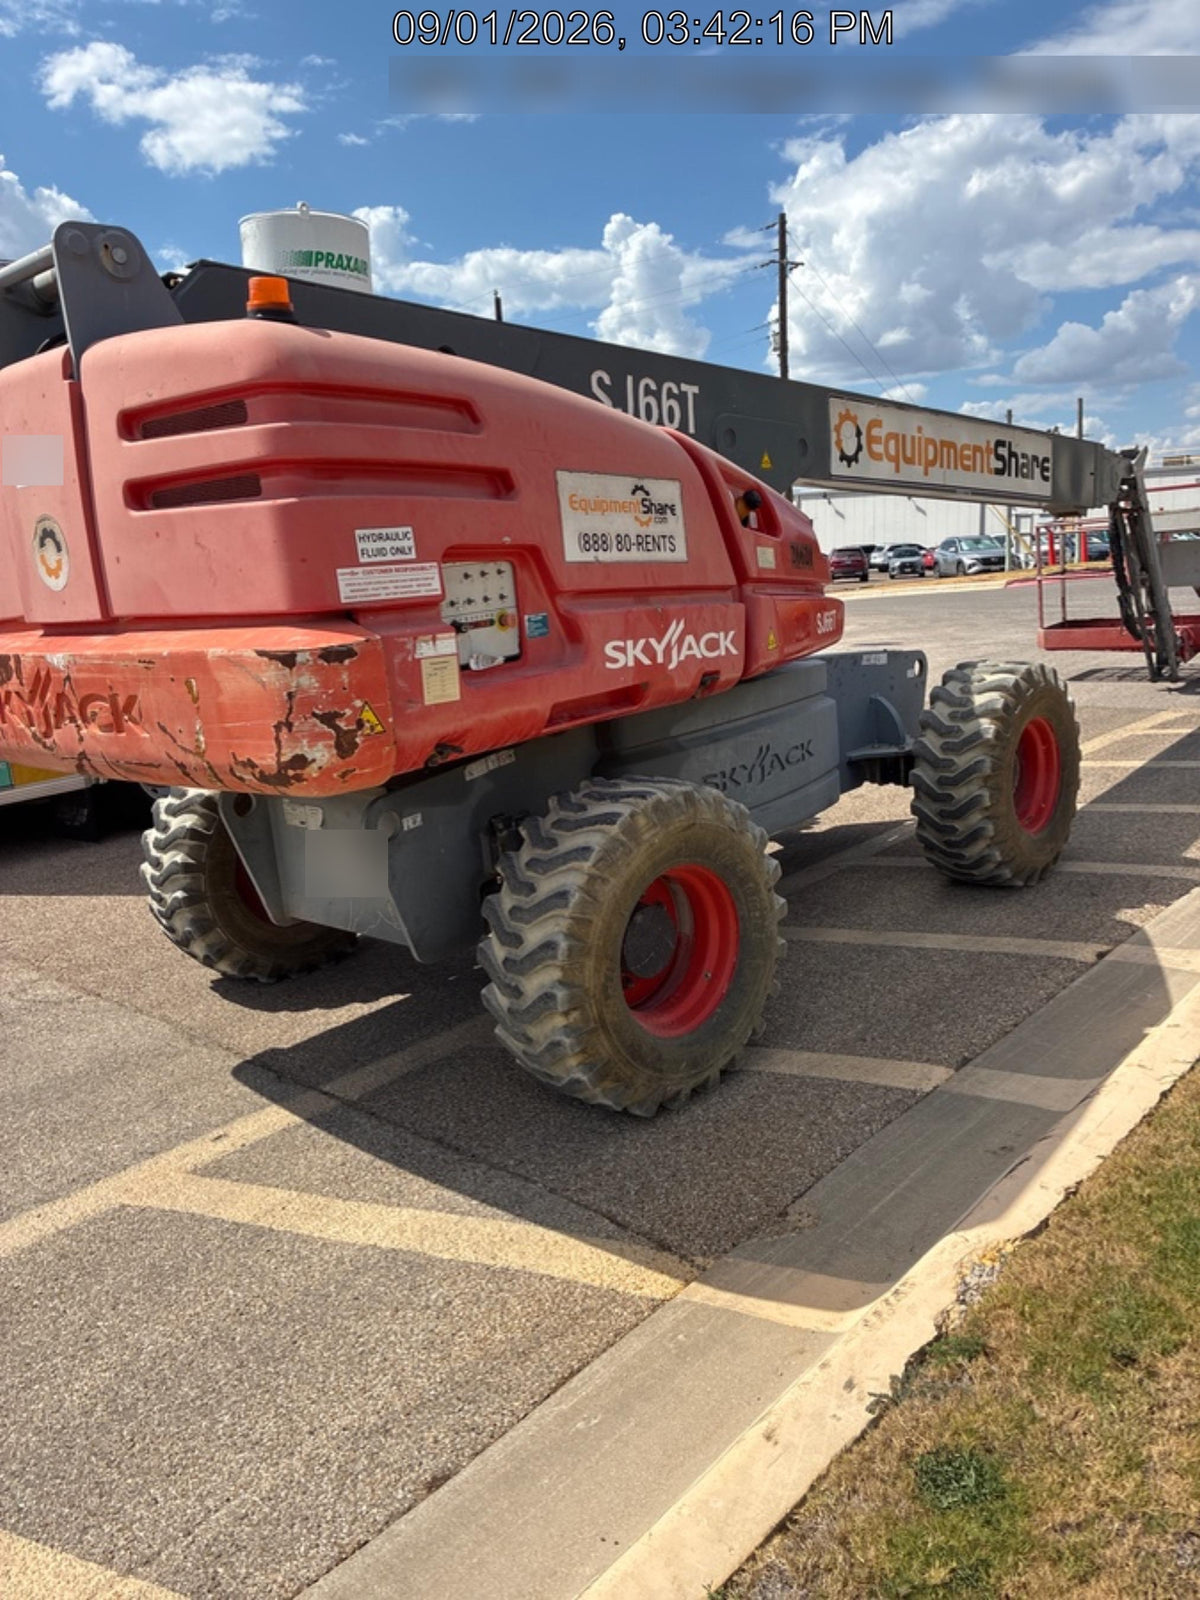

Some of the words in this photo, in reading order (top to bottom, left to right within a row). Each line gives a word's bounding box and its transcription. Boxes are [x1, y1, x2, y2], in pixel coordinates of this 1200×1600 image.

[865, 418, 1050, 482] EquipmentShare
[568, 492, 677, 516] EquipmentShare
[358, 530, 412, 543] HYDRAULIC
[578, 532, 614, 554] (888)
[615, 533, 677, 554] 80-RENTS
[360, 546, 388, 559] FLUID
[389, 545, 413, 557] ONLY
[603, 617, 739, 671] SKYJACK
[701, 739, 815, 792] SKYJACK
